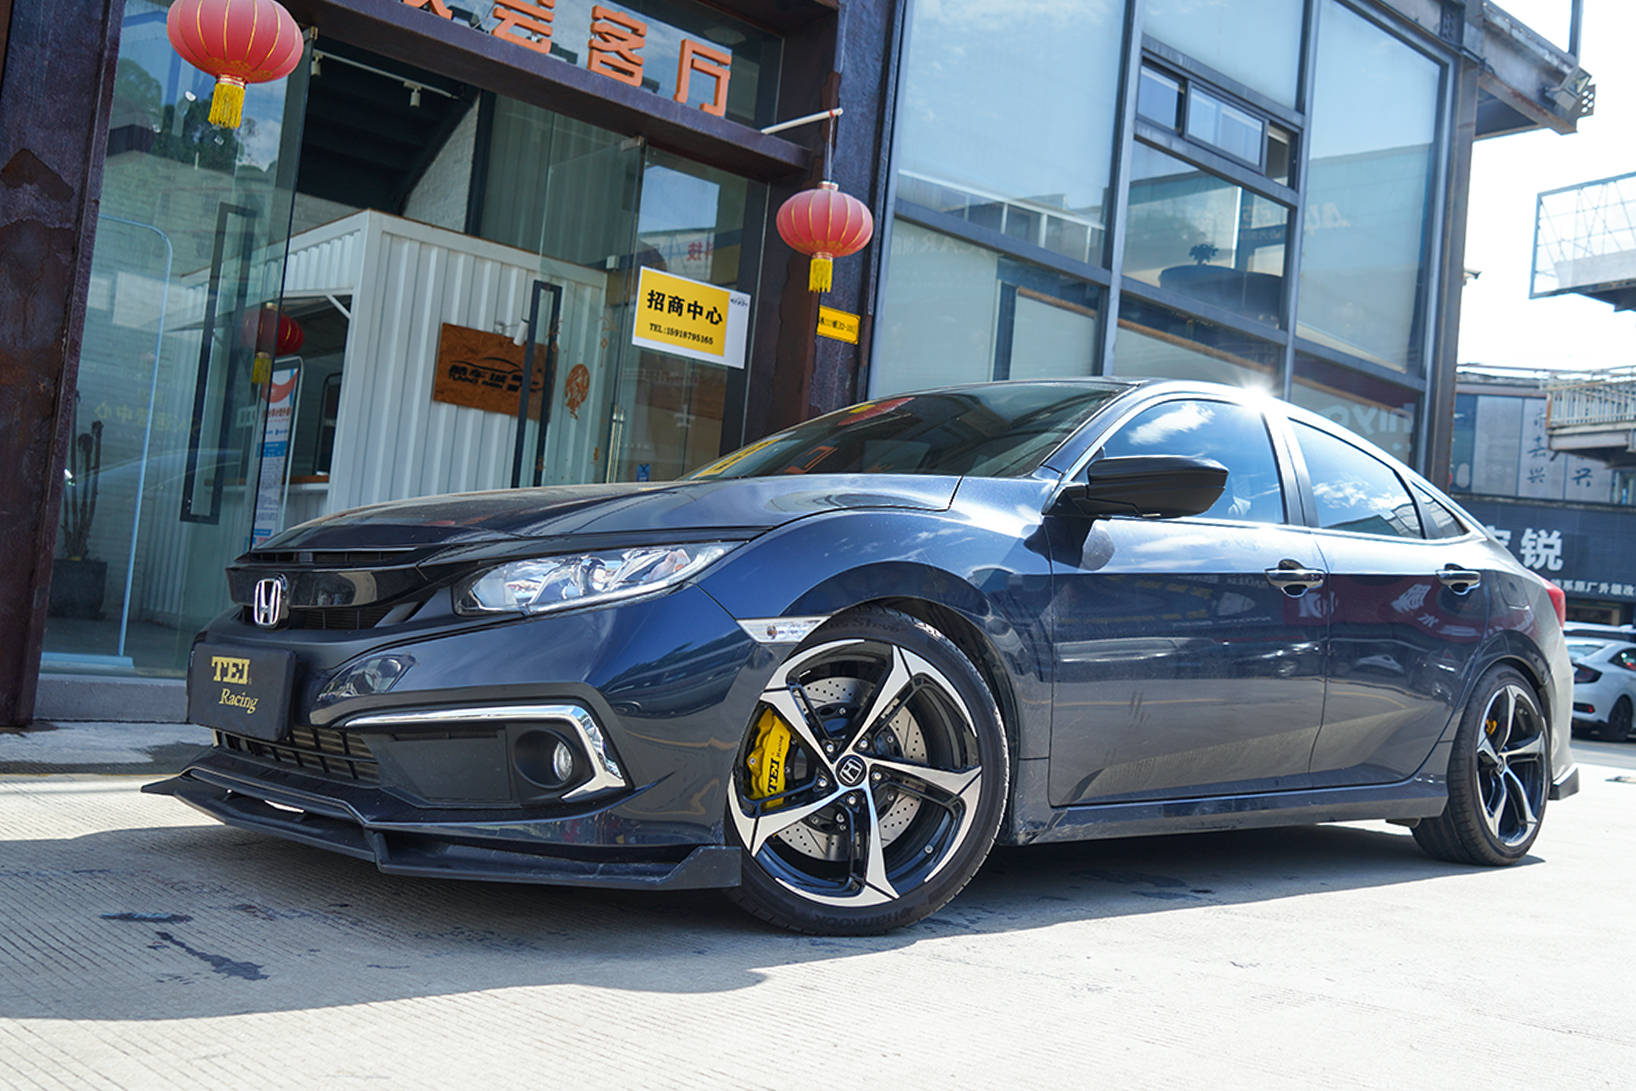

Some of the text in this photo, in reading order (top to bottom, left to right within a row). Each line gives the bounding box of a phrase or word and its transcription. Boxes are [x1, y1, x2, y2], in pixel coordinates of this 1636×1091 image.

[647, 290, 723, 325] 招商中心
[211, 656, 251, 685] TEI
[218, 688, 259, 714] Racing
